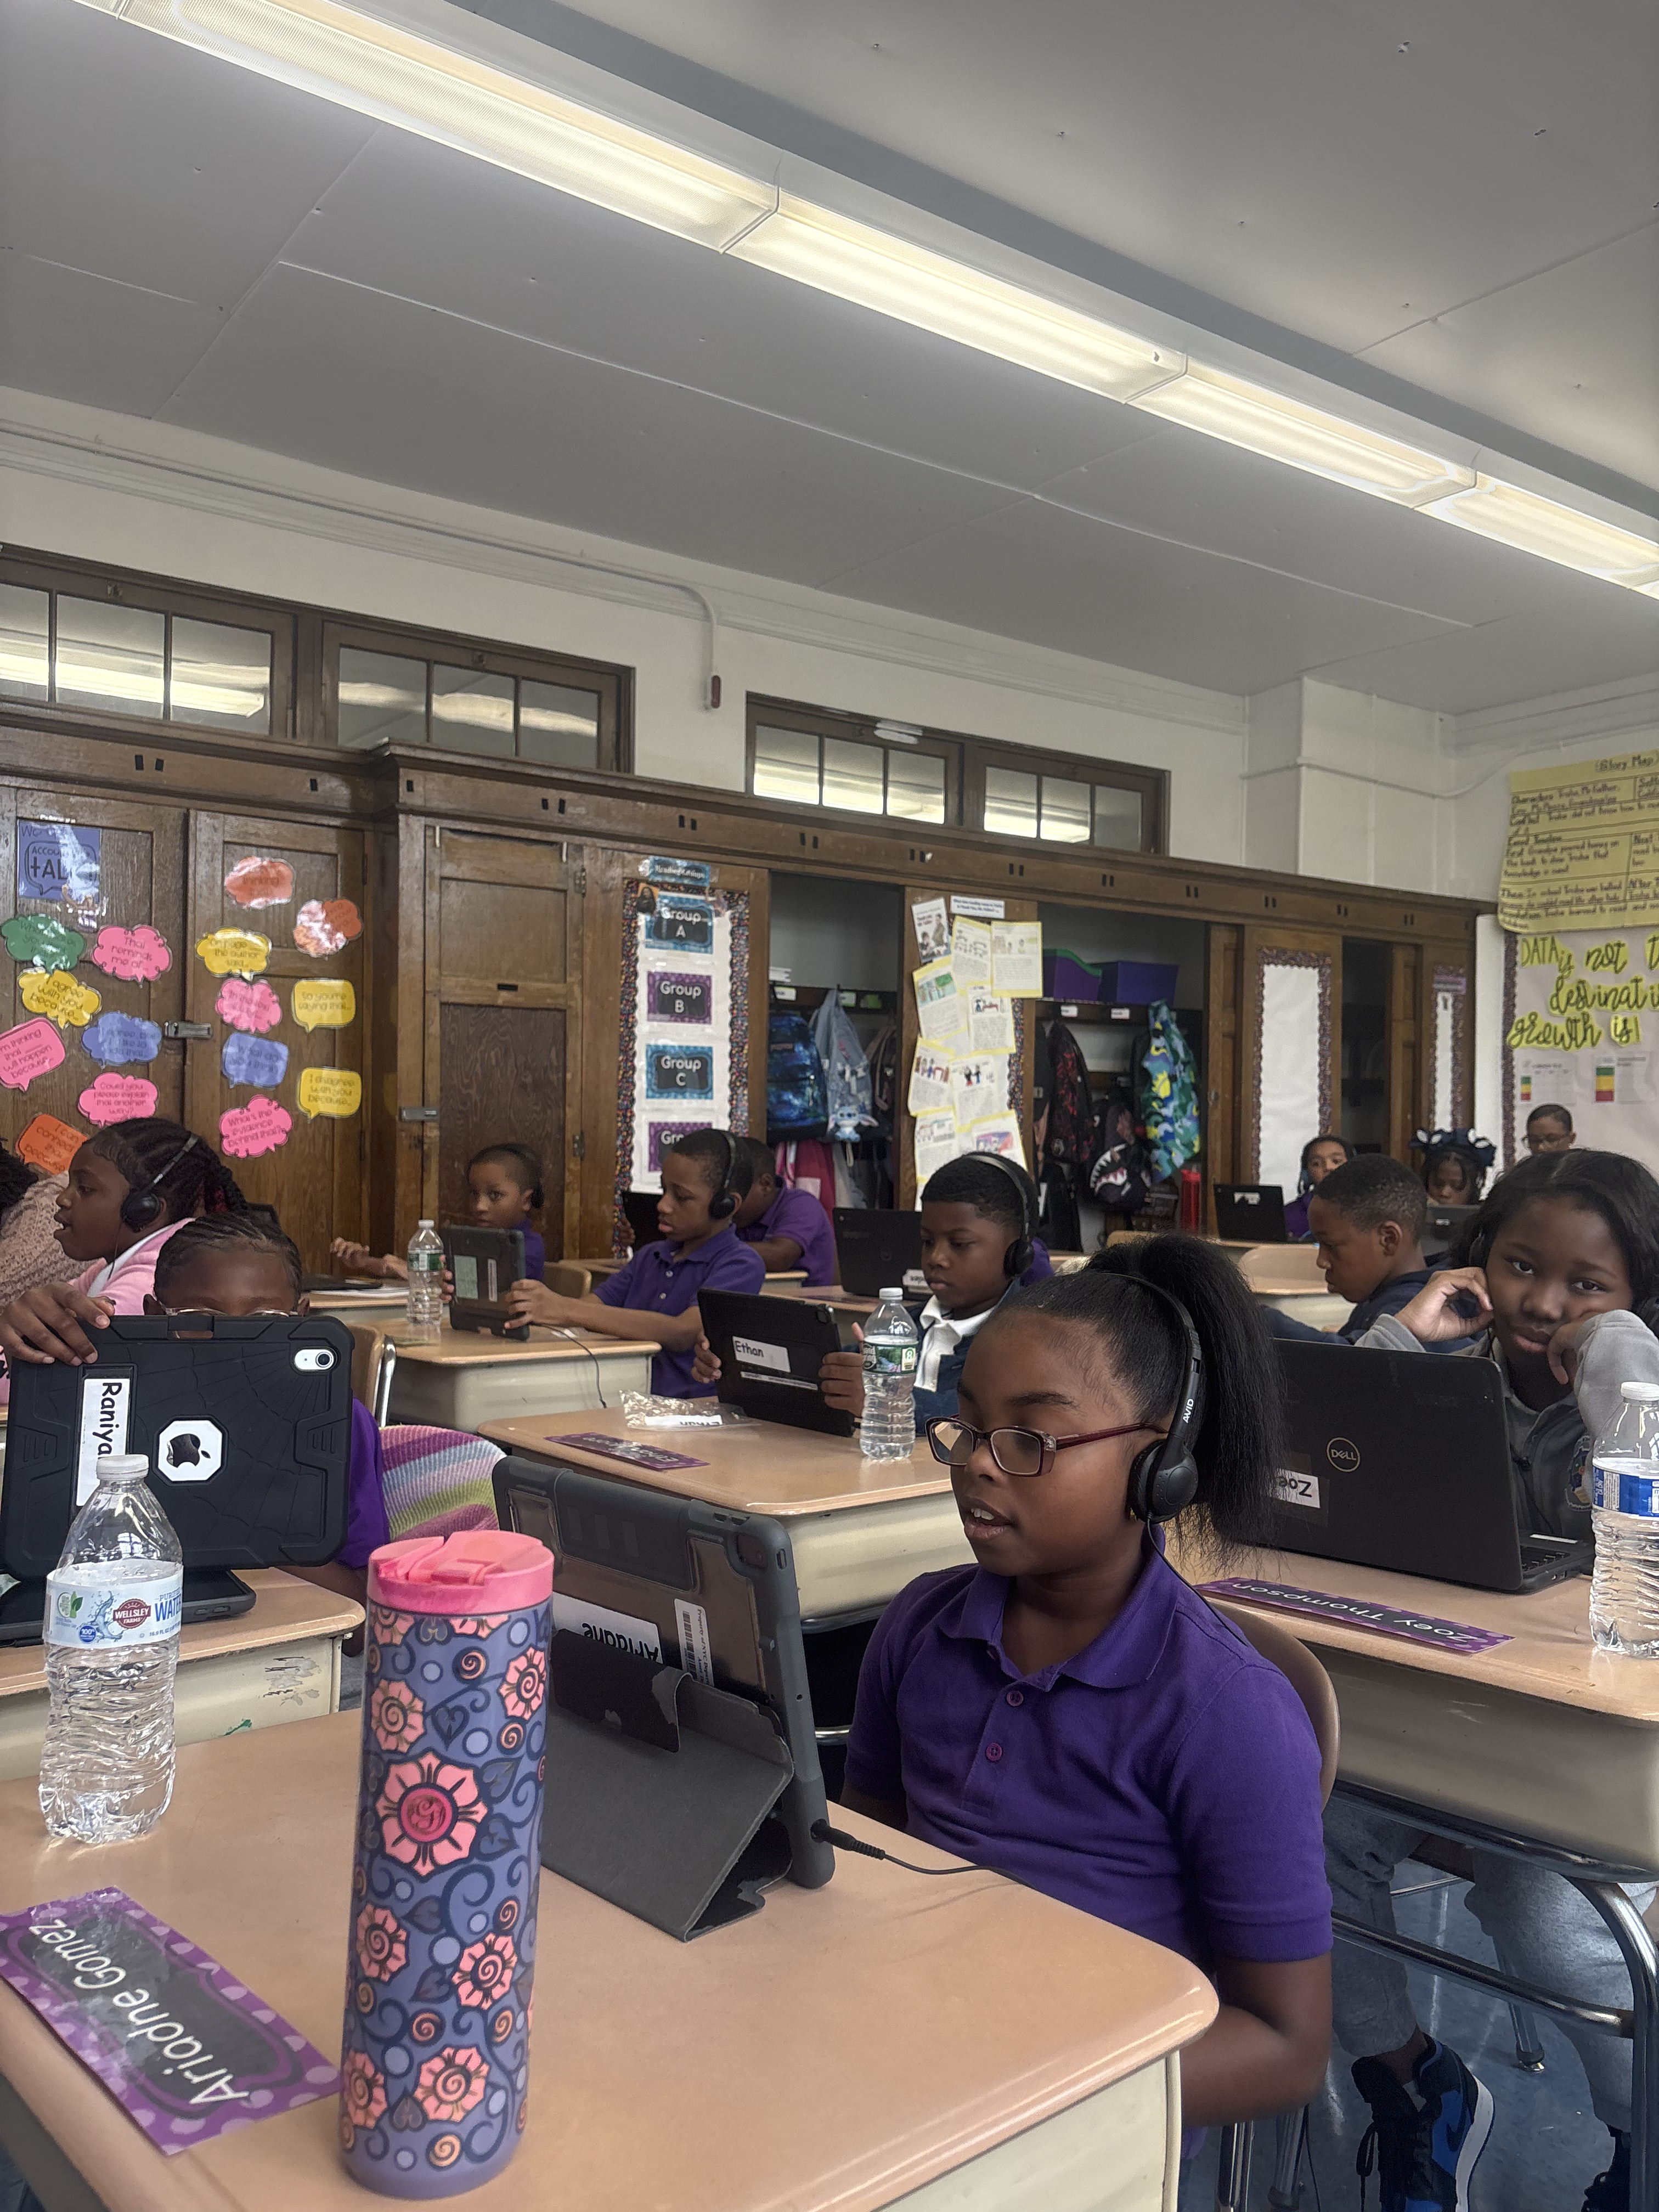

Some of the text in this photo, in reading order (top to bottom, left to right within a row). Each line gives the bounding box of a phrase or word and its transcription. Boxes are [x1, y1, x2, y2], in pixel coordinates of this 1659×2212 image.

[661, 907, 701, 925] Group
[675, 924, 686, 938] A
[1521, 935, 1557, 967] DATA
[1585, 940, 1626, 974] not
[660, 980, 702, 1000] Group
[1550, 974, 1659, 1014] destinati
[675, 999, 684, 1013] B
[1509, 1011, 1602, 1050] growth
[661, 1055, 702, 1073] Group
[676, 1072, 686, 1086] C
[735, 1340, 764, 1358] Ethan
[92, 1382, 122, 1458] Raniya
[1182, 1398, 1194, 1423] AVID
[1331, 1449, 1357, 1460] DELL
[1277, 1476, 1313, 1498] Zoe
[115, 1607, 149, 1619] WELLSLEY
[1232, 1583, 1477, 1643] Zoey Thompson
[29, 1918, 249, 2104] Ariadne Gomez
